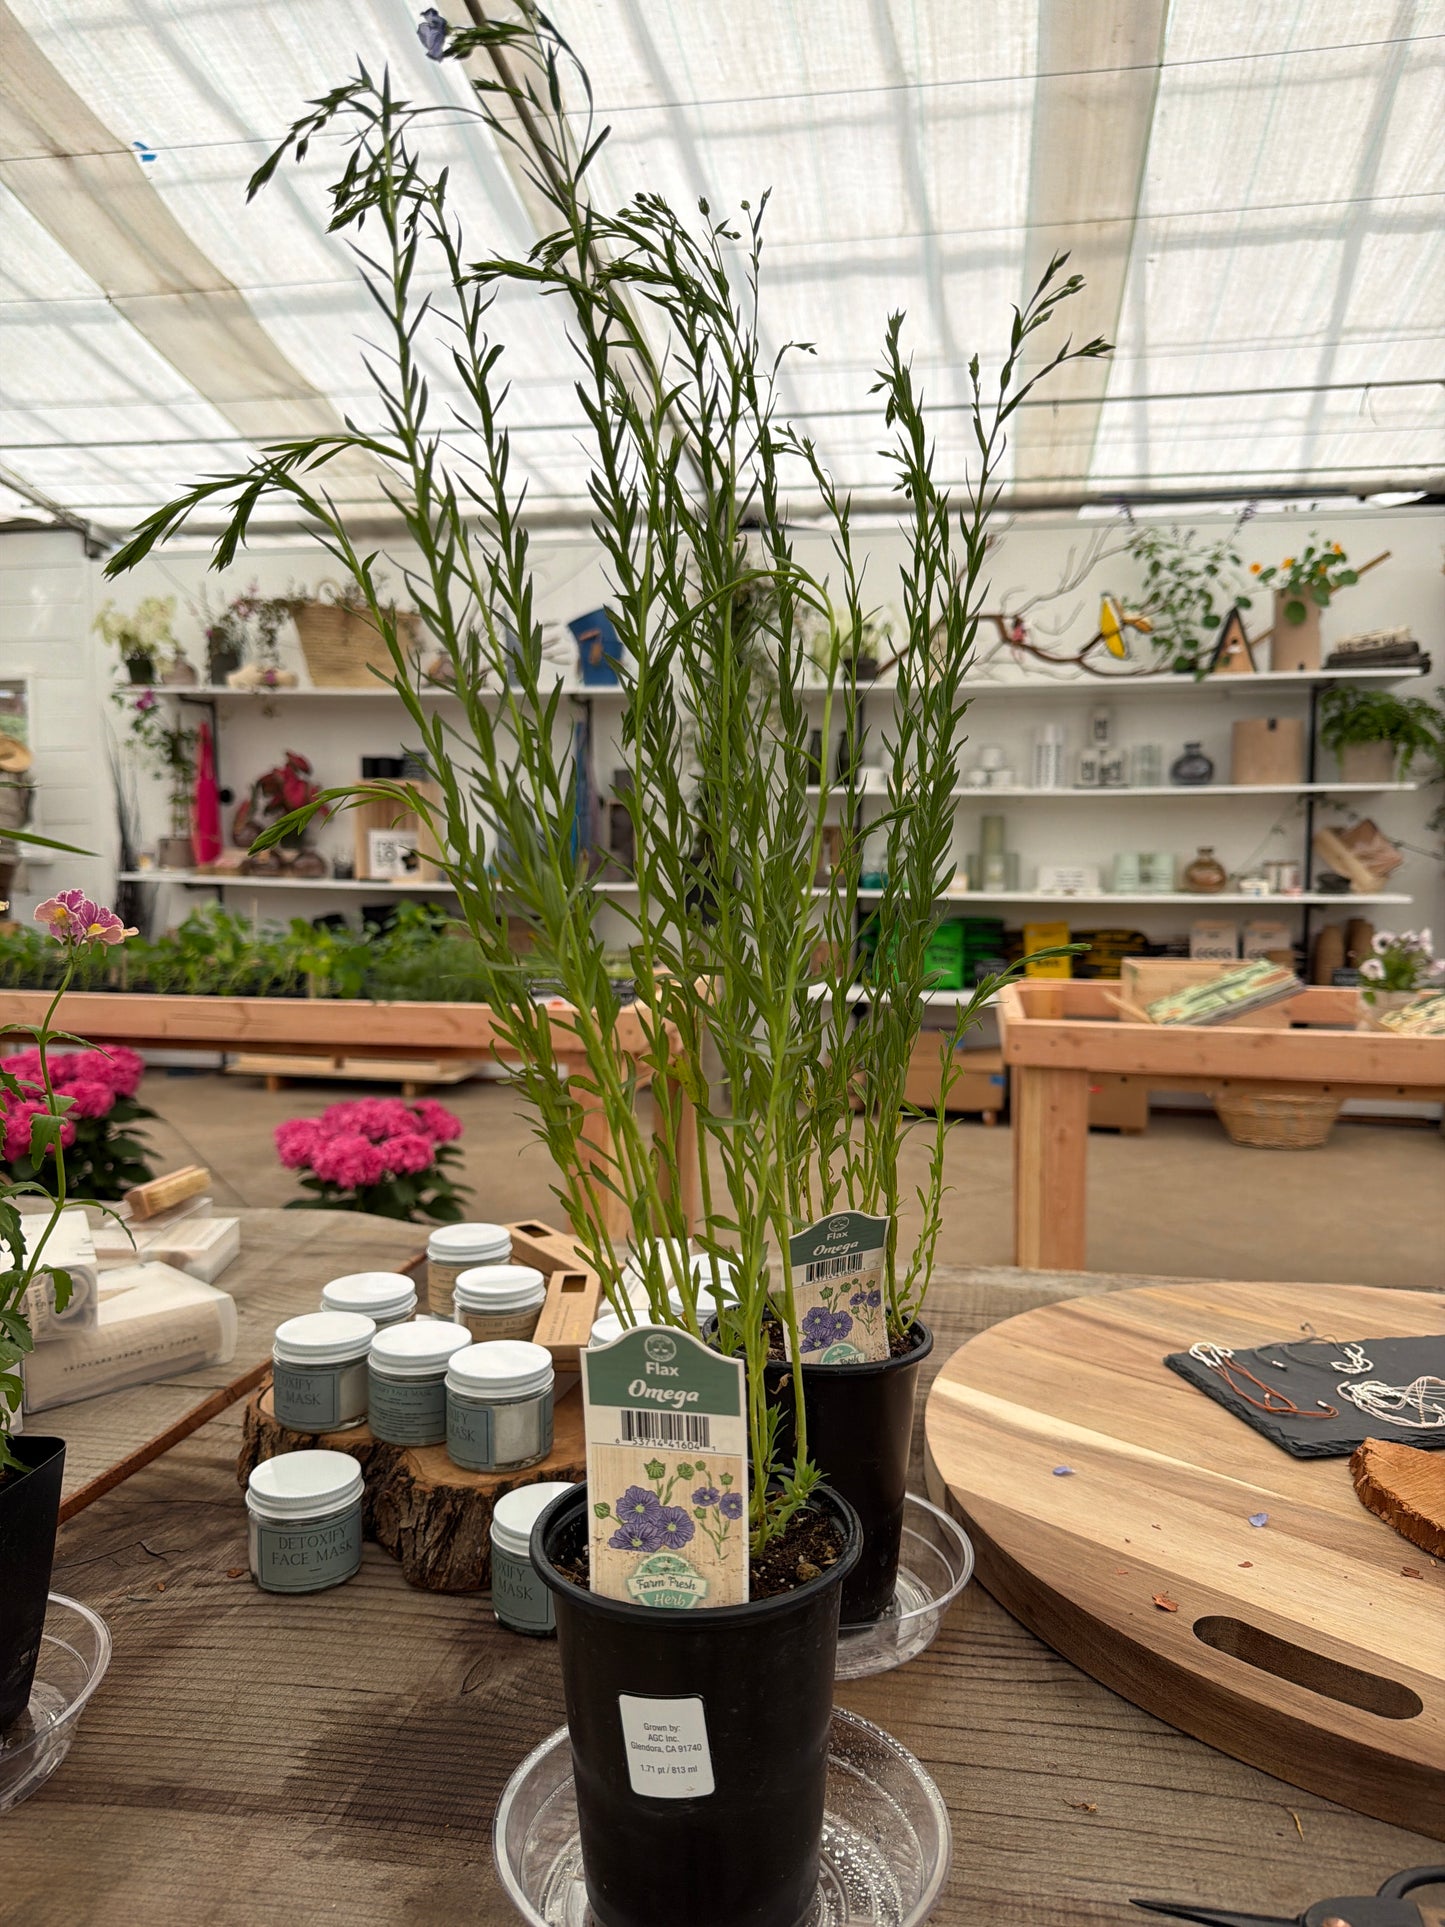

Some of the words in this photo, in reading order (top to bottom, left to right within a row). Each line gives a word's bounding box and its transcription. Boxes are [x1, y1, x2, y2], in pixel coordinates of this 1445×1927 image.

[826, 1231, 849, 1241] Flax
[813, 1241, 859, 1256] Omega
[645, 1361, 680, 1377] Flax
[286, 1390, 321, 1406] MASK
[628, 1379, 700, 1409] Omega
[668, 1440, 700, 1450] 41604
[279, 1524, 347, 1550] DETOXIFY
[271, 1551, 309, 1567] FACE
[316, 1536, 353, 1563] MASK
[499, 1576, 533, 1601] MASK
[636, 1578, 665, 1590] Farm
[668, 1575, 697, 1591] Fresh
[654, 1592, 686, 1607] Herb
[643, 1722, 668, 1732] Grown
[669, 1724, 681, 1733] by:
[648, 1734, 664, 1743] AGC
[665, 1734, 680, 1743] Inc.
[630, 1741, 665, 1754] Glendora,
[665, 1745, 677, 1753] CA
[679, 1743, 702, 1753] 91740
[640, 1764, 655, 1772] 1.71
[657, 1766, 665, 1775] pt
[671, 1766, 686, 1774] 813
[688, 1765, 698, 1773] ml
